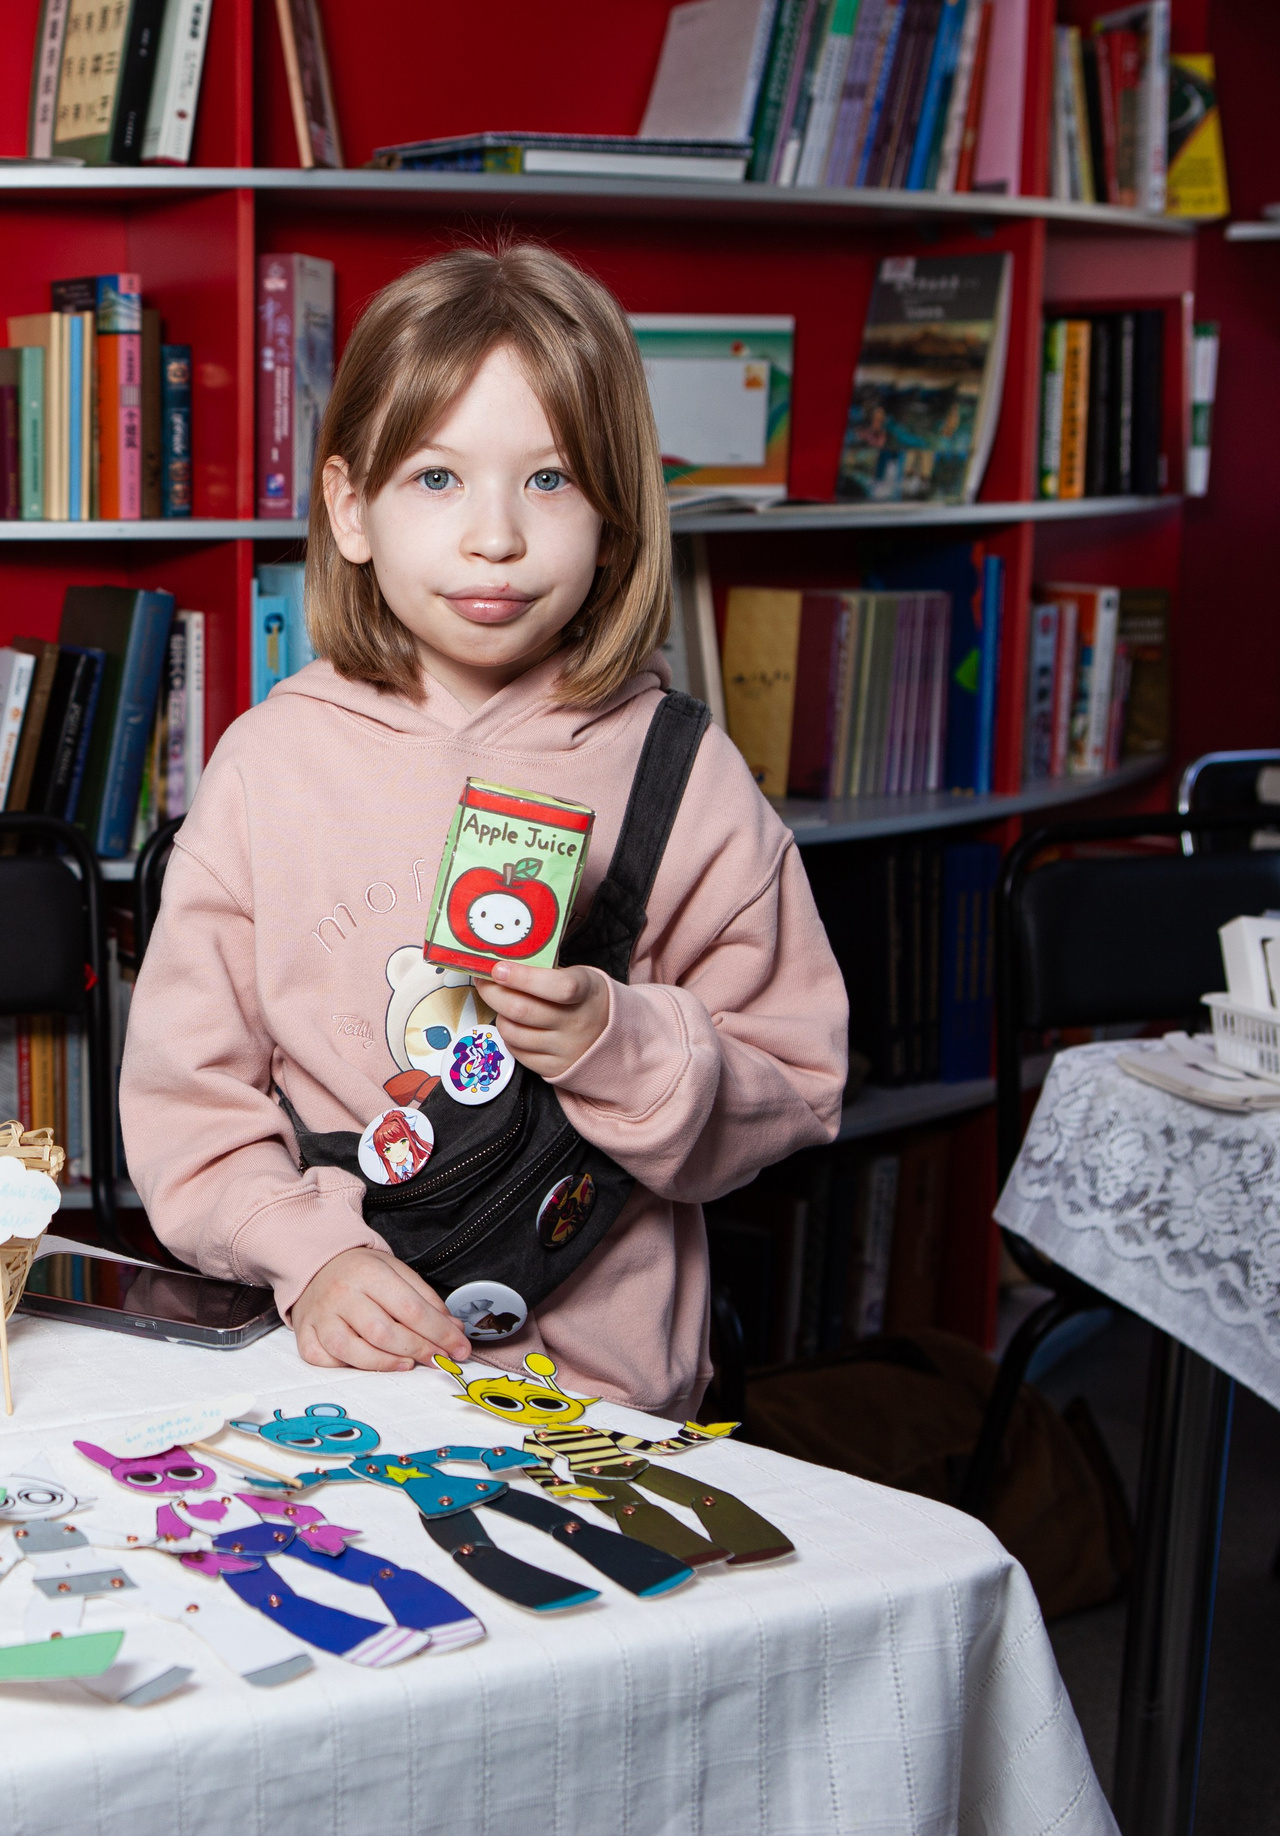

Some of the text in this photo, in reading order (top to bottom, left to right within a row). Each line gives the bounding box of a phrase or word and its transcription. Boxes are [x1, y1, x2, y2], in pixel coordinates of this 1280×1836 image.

[462, 813, 578, 858] Apple Juice
[311, 858, 426, 954] mof
